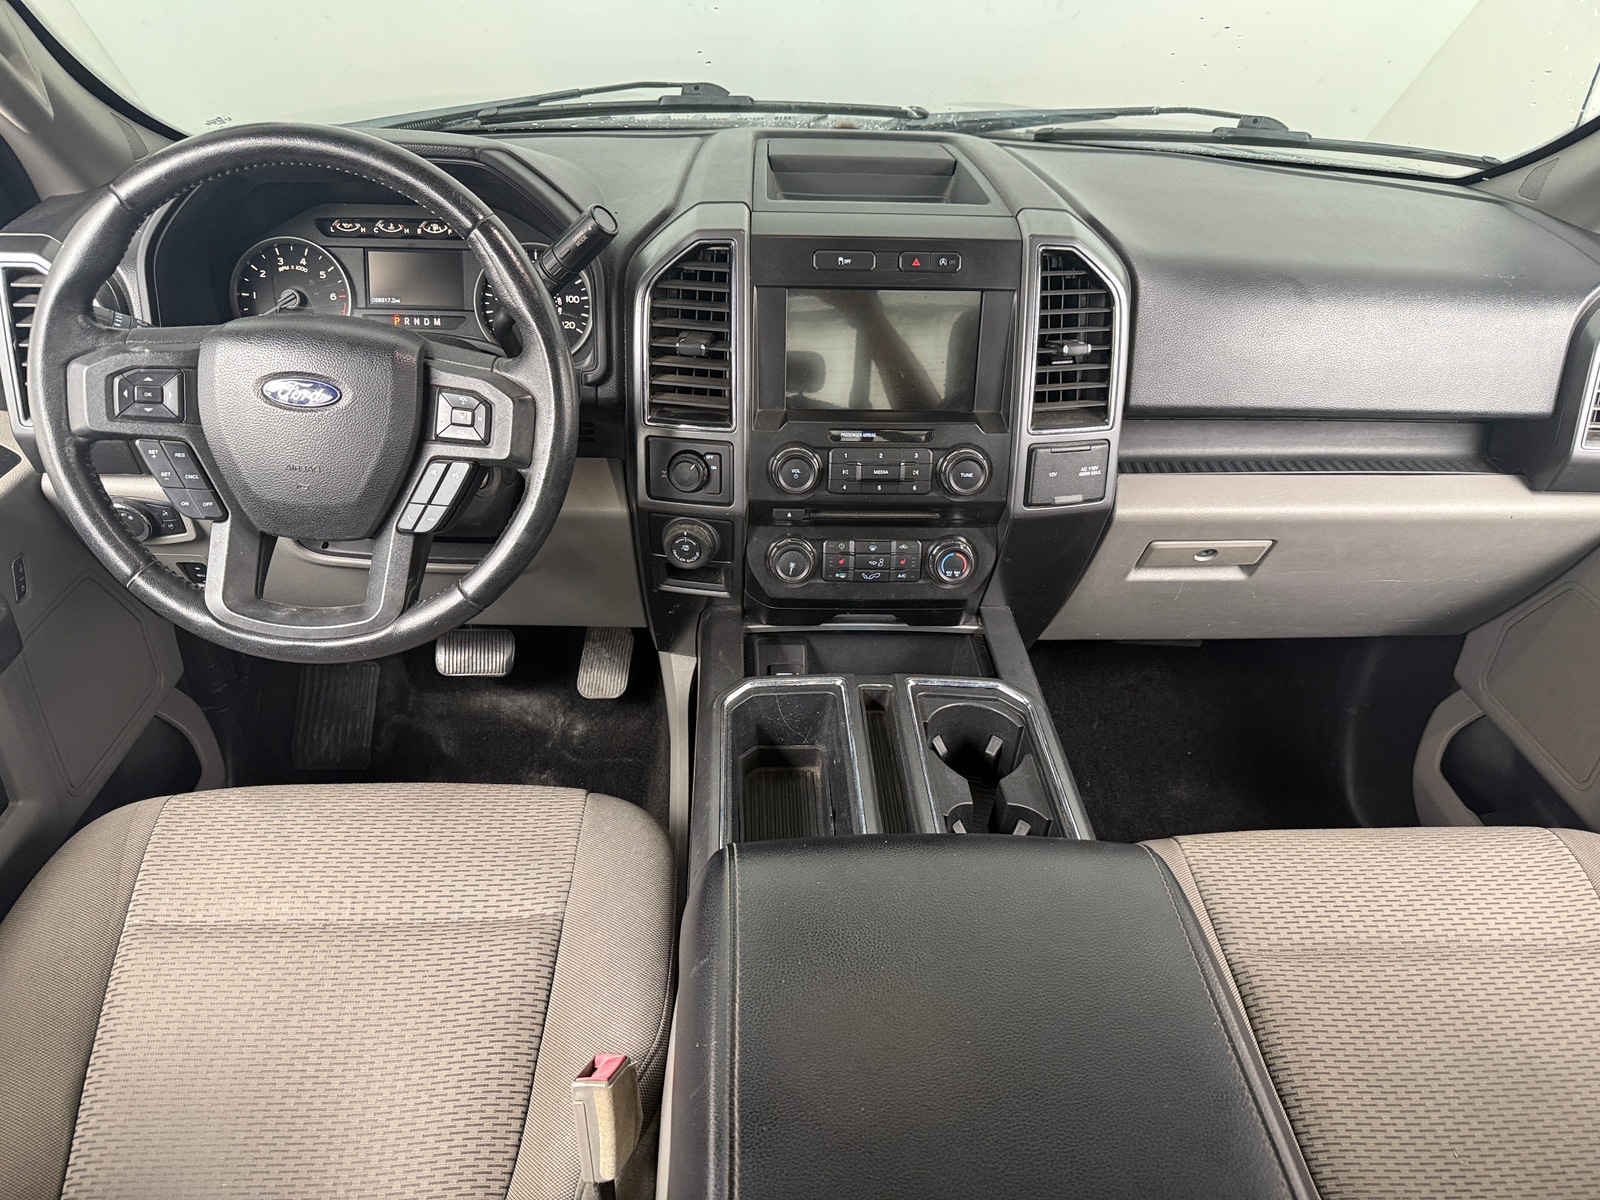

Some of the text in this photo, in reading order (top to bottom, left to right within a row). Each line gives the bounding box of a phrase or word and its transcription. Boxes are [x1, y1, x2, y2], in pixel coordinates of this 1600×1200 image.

[277, 257, 284, 266] 3
[300, 258, 307, 266] 4
[295, 265, 309, 273] 1000
[330, 292, 337, 300] 6
[566, 295, 580, 304] 100
[394, 317, 440, 326] P R N D M
[270, 381, 334, 403] Ford
